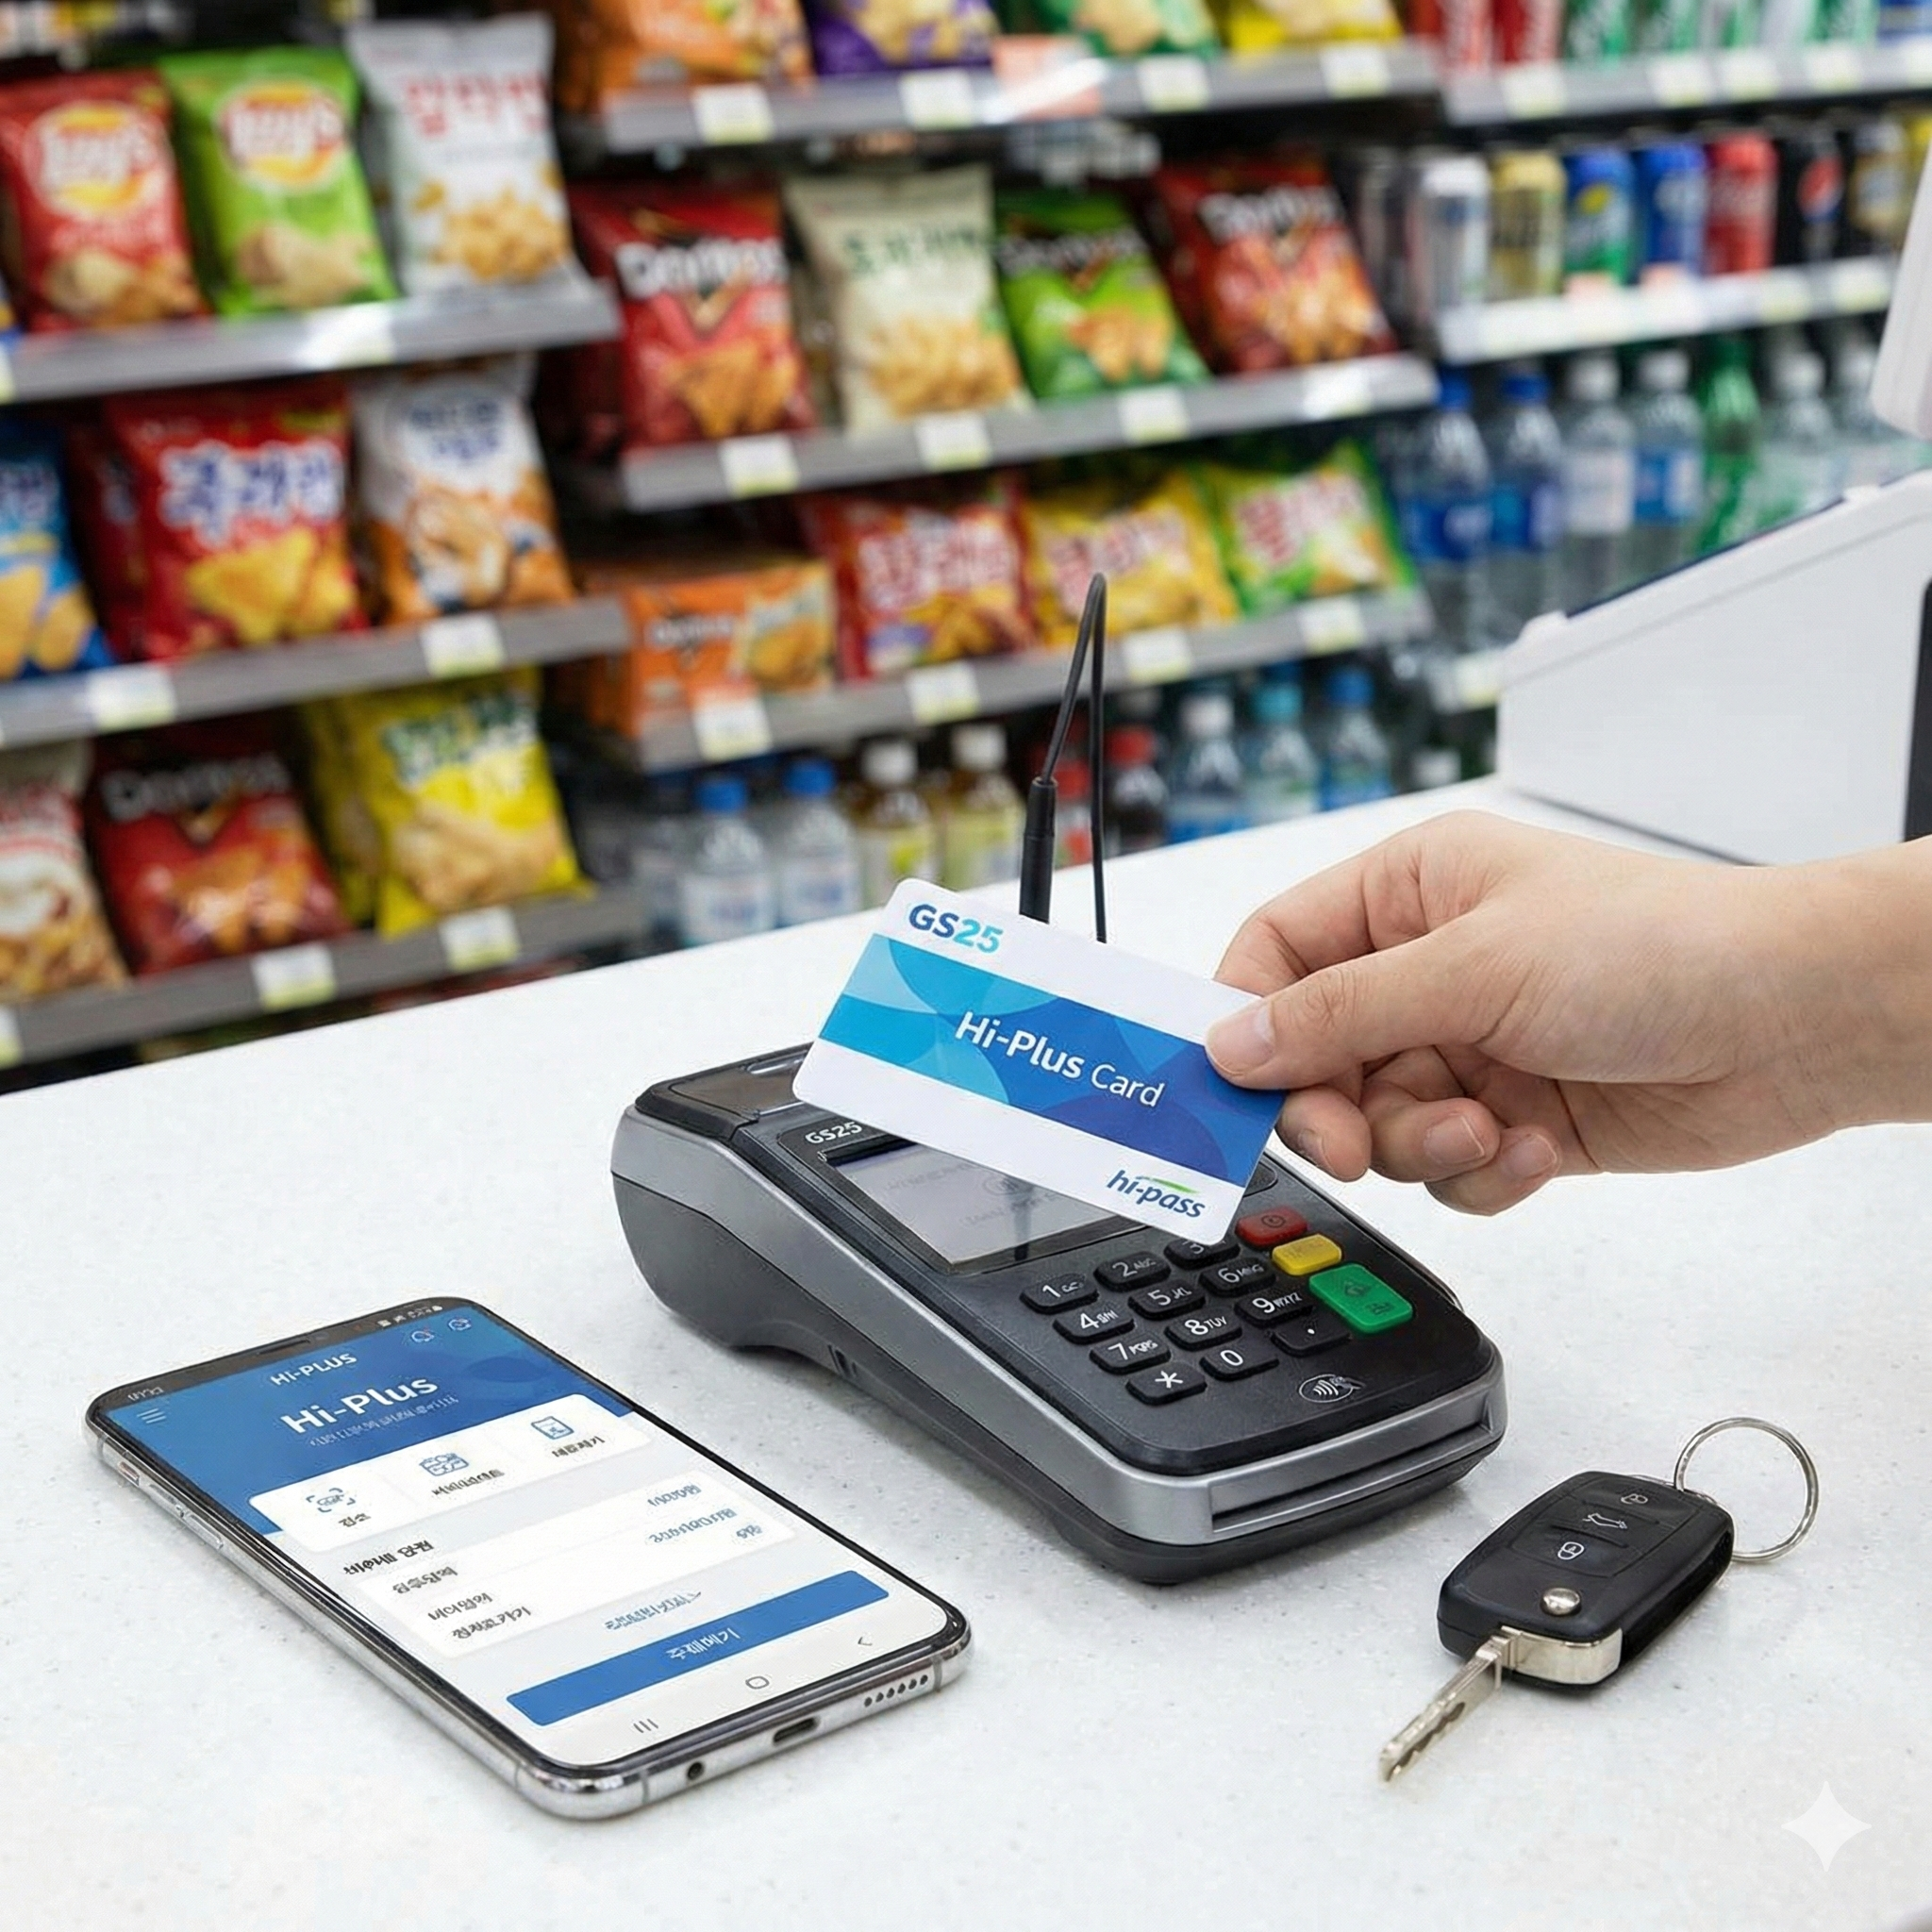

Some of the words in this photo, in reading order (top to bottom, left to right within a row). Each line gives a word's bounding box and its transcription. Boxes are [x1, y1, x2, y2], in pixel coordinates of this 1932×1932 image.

[908, 904, 1004, 953] GS25
[955, 1011, 1085, 1078] Hi-Plus
[1091, 1064, 1165, 1108] Card
[805, 1121, 862, 1144] GS25
[1107, 1170, 1206, 1218] hi-pass
[1112, 1261, 1138, 1277] 2
[1218, 1267, 1240, 1283] 6
[1042, 1284, 1061, 1298] 1
[1147, 1290, 1172, 1306] 5
[1252, 1297, 1275, 1313] 9
[1080, 1312, 1100, 1329] 4
[1184, 1319, 1208, 1335] 8
[1108, 1342, 1128, 1360] 7
[280, 1378, 439, 1434] Hi-Plus
